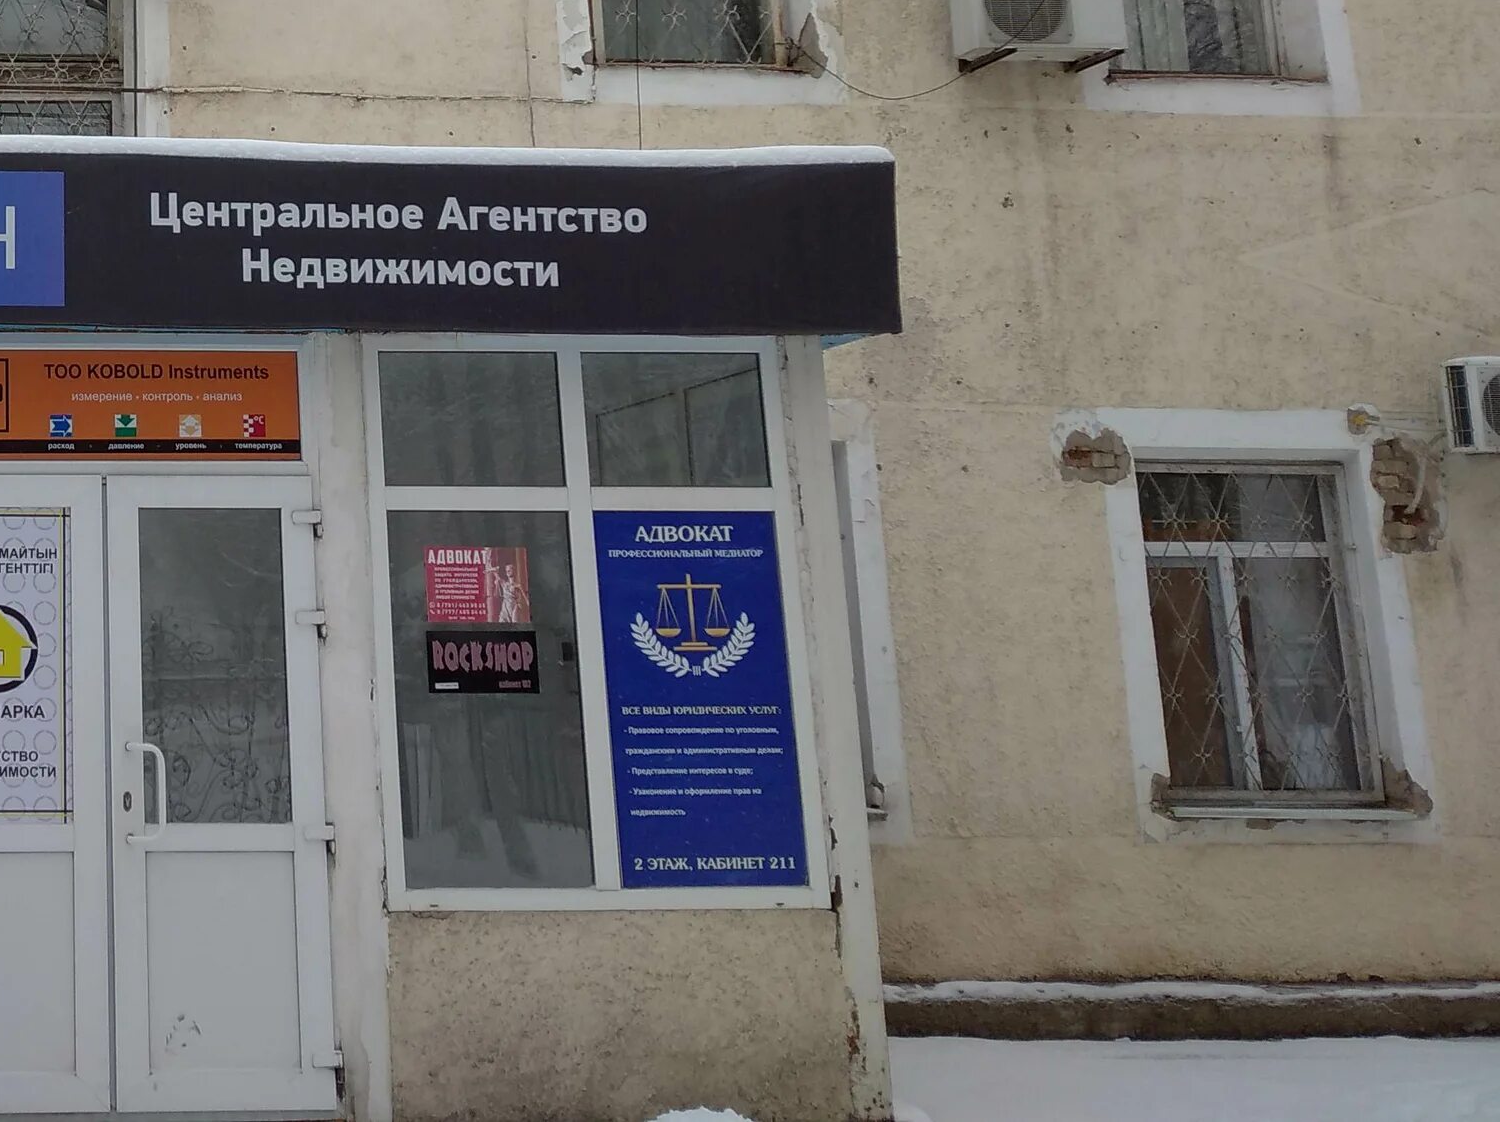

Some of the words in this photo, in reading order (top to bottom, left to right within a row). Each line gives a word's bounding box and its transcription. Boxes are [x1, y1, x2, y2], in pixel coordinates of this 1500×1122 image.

[150, 192, 423, 237] Центральное
[437, 196, 648, 233] Агентство
[241, 248, 559, 289] Недвижимости
[87, 364, 163, 379] KOBOLD
[169, 364, 270, 380] Instruments
[71, 392, 133, 403] измерение
[142, 393, 193, 404] контроль
[202, 393, 243, 402] анализ
[47, 443, 75, 452] расход
[108, 443, 145, 451] давление
[175, 443, 207, 452] уровень
[234, 443, 283, 451] температура
[635, 525, 734, 543] АДВОКАТ
[428, 549, 488, 565] АДВОКАТ
[608, 548, 713, 558] ПРОФЕССИОНАЛЬНЫЙ
[714, 549, 764, 558] МЕДИАТОР
[621, 706, 641, 715] ВСЕ
[643, 706, 671, 715] ВИДЫ
[673, 706, 747, 715] ЮРИДИЧЕСКИХ
[634, 858, 644, 870] 2
[647, 857, 694, 871] ЭТАЖ,
[697, 857, 766, 870] КАБИНЕТ
[770, 857, 796, 870] 211
